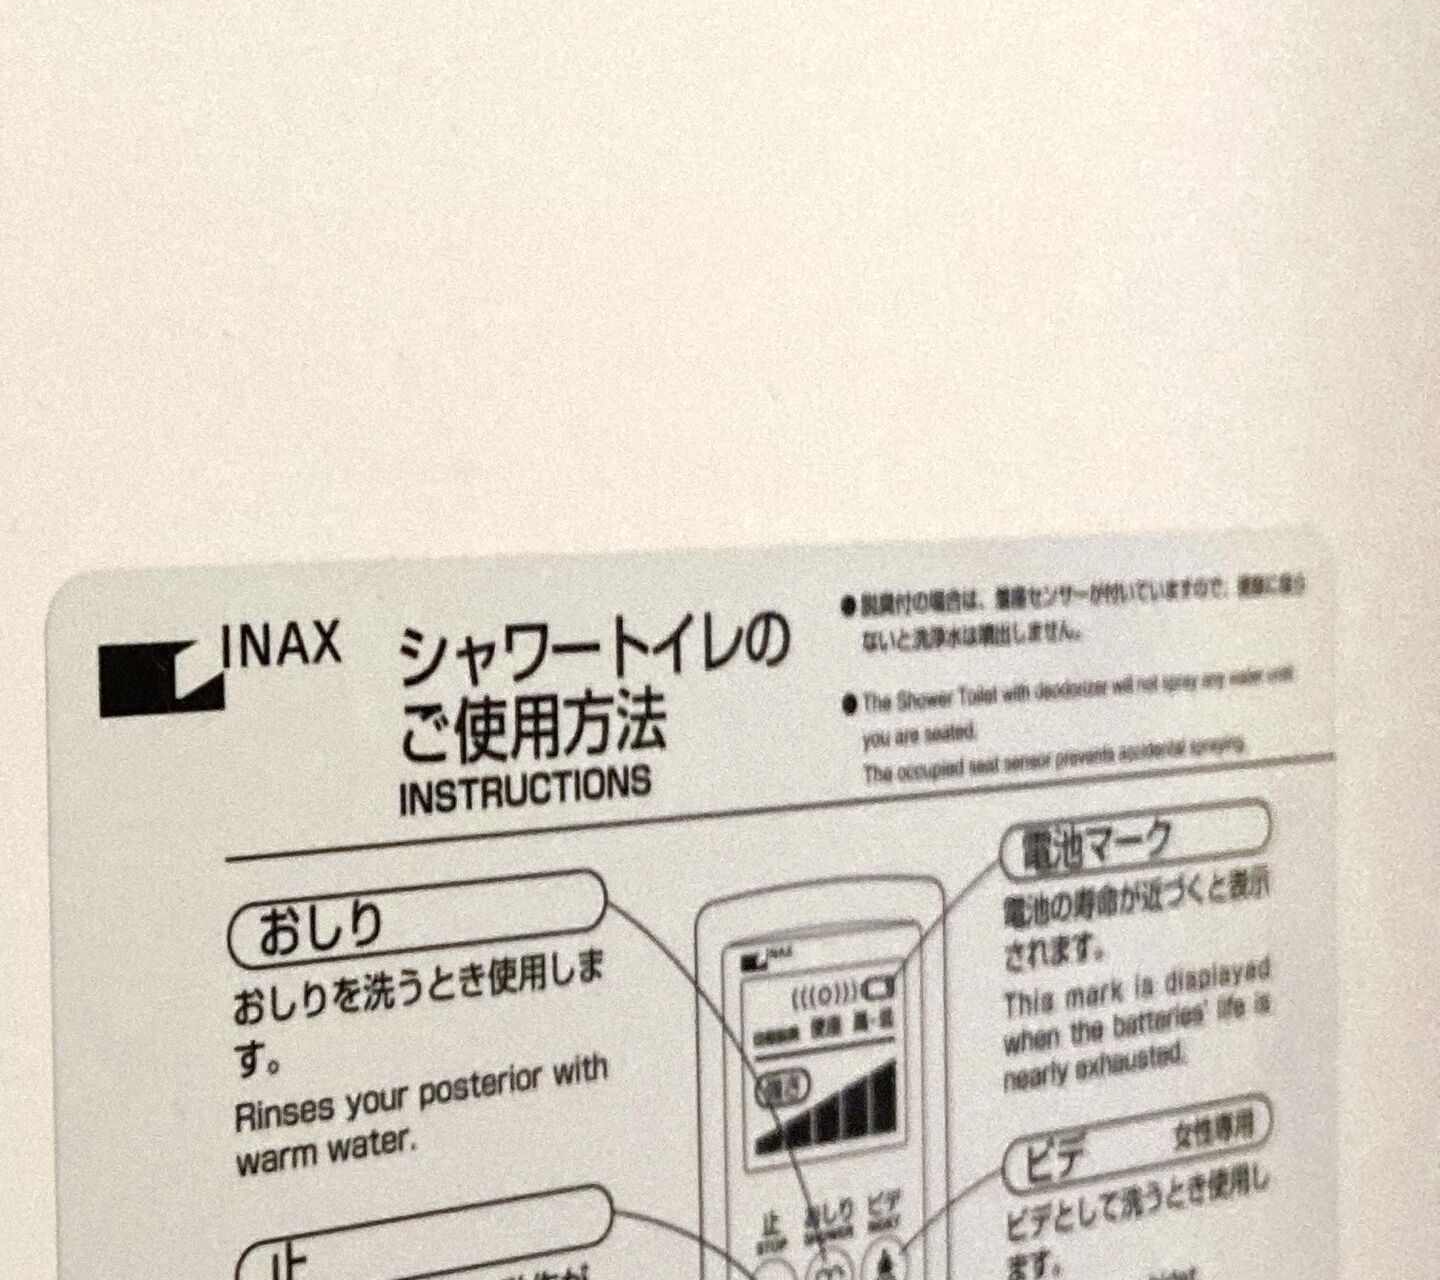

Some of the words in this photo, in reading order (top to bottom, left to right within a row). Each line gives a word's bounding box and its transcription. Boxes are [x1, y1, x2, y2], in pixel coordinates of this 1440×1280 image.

[222, 619, 342, 669] INAX
[399, 611, 791, 688] シャワートイレの
[863, 691, 891, 713] The
[897, 689, 953, 712] Shower
[958, 684, 997, 706] Toilet
[1003, 682, 1031, 703] with
[402, 686, 668, 765] ご使用方法
[863, 729, 890, 754] you
[895, 728, 919, 746] are
[399, 764, 652, 818] INSTRUCTIONS
[863, 762, 892, 784] The
[897, 758, 964, 784] occupied
[1022, 816, 1172, 871] 電池マーク
[1004, 863, 1270, 929] 電池の寿命が近づくと表示
[260, 898, 382, 956] おしり
[1005, 931, 1104, 974] されます。
[233, 948, 603, 1026] おしりを洗うとき使用しま
[1005, 988, 1054, 1019] This
[1065, 979, 1124, 1010] mark
[1135, 972, 1154, 999] is
[1165, 955, 1271, 997] displayed
[234, 1040, 281, 1078] す。
[1004, 1027, 1061, 1057] when
[1070, 1019, 1104, 1046] the
[235, 1094, 334, 1132] Rinses
[346, 1084, 407, 1122] your
[419, 1066, 543, 1111] posterior
[553, 1053, 609, 1087] with
[1004, 1060, 1069, 1094] nearly
[236, 1143, 318, 1177] warm
[328, 1125, 417, 1164] water.
[1027, 1128, 1087, 1184] ビデ
[1174, 1107, 1254, 1151] 女性専用
[1007, 1161, 1269, 1242] ビデとして洗うとき使用し
